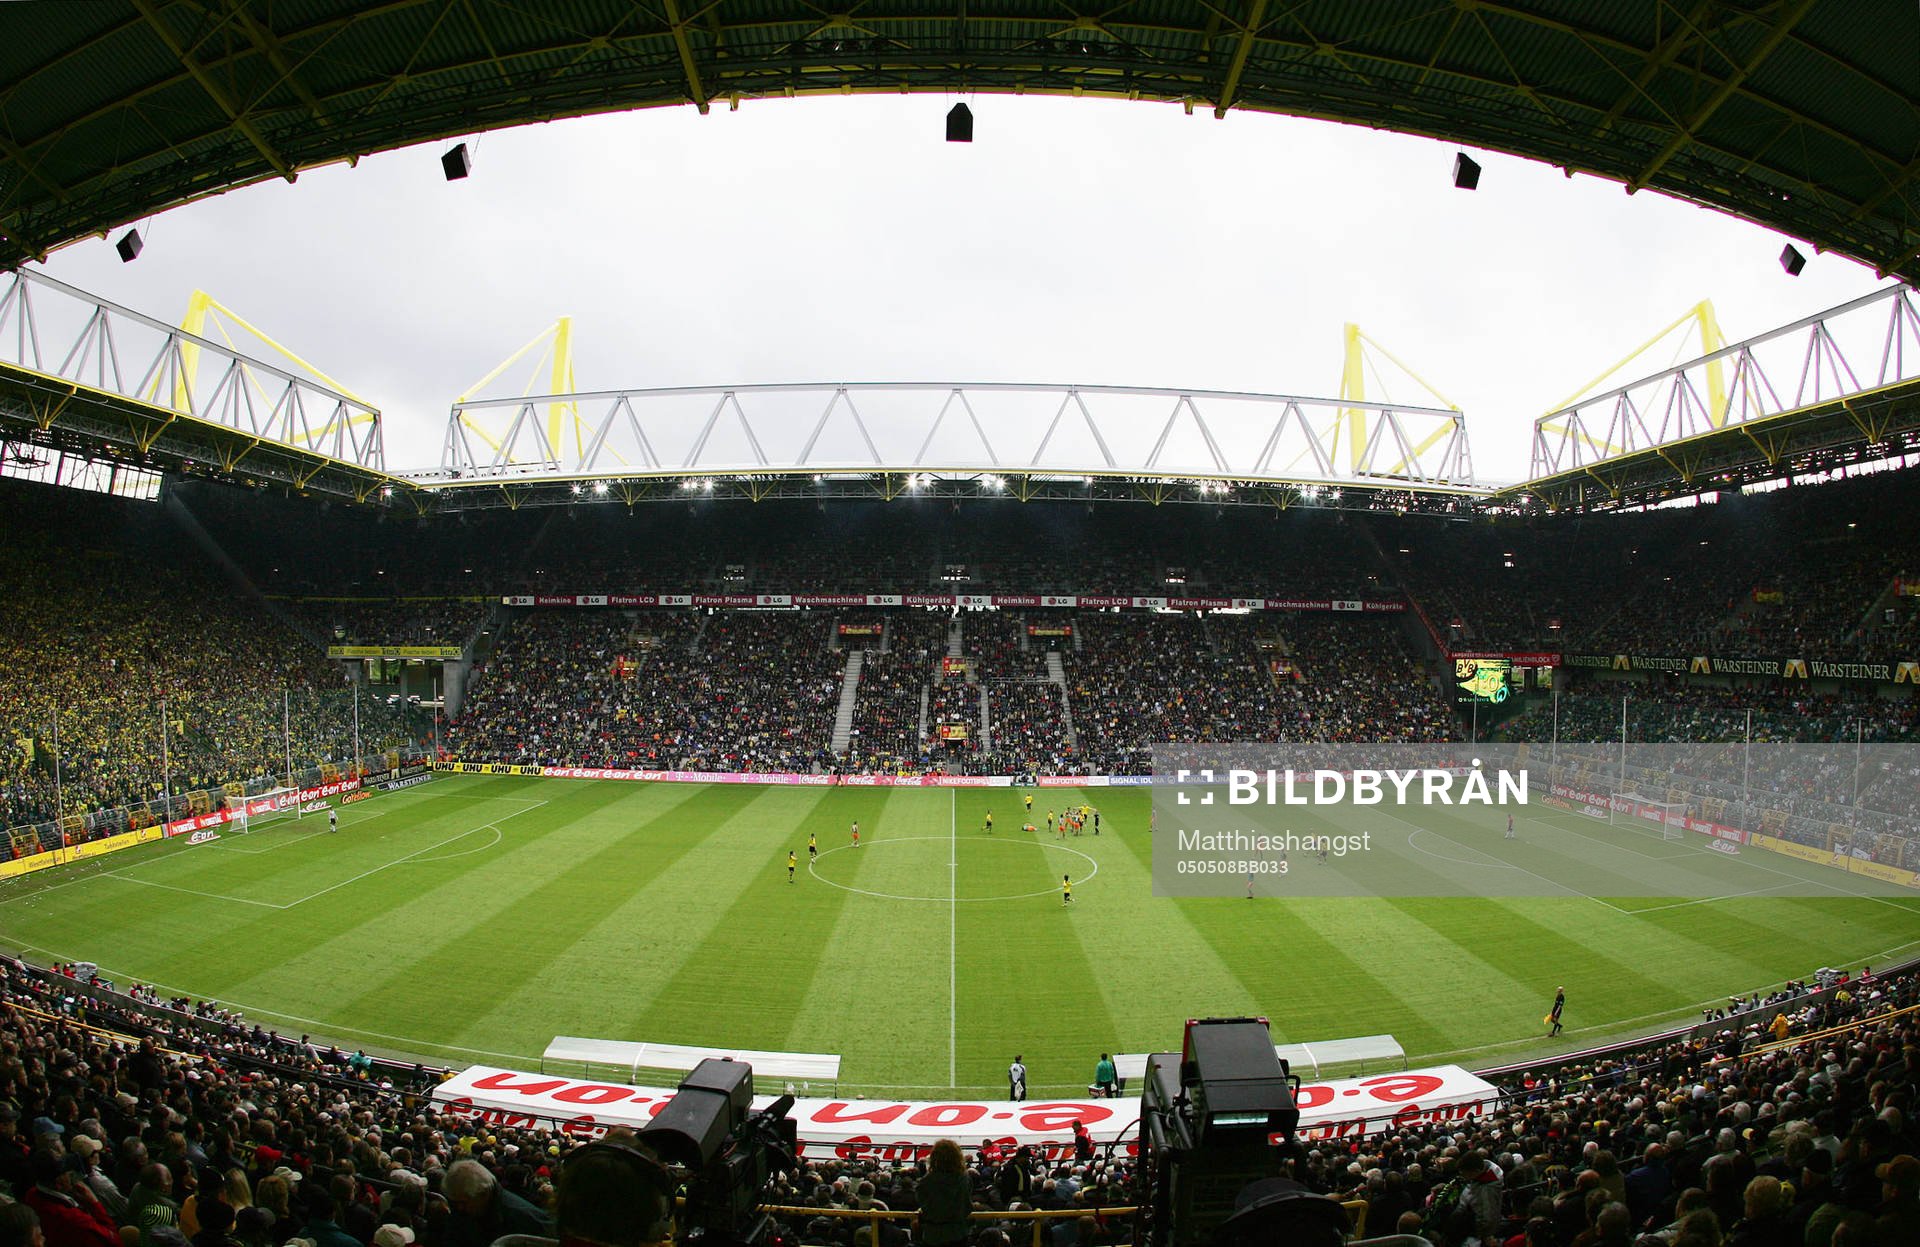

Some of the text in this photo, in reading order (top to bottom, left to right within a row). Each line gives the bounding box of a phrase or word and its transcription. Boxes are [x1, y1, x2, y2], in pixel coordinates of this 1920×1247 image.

[906, 596, 950, 605] Kühlgeräte
[1200, 599, 1228, 607] Plasma
[1268, 600, 1330, 609] Waschmaschinen
[1564, 655, 1610, 668] WARSTEINER
[1632, 655, 1688, 670] WARSTEINER
[1713, 658, 1780, 675] WARSTEINER
[1811, 661, 1890, 680] WARSTEINER
[436, 762, 455, 771] UHU
[463, 763, 482, 772] UHU
[491, 764, 511, 774] UHU
[520, 765, 541, 775] UHU
[388, 774, 432, 790] WARSTEINER
